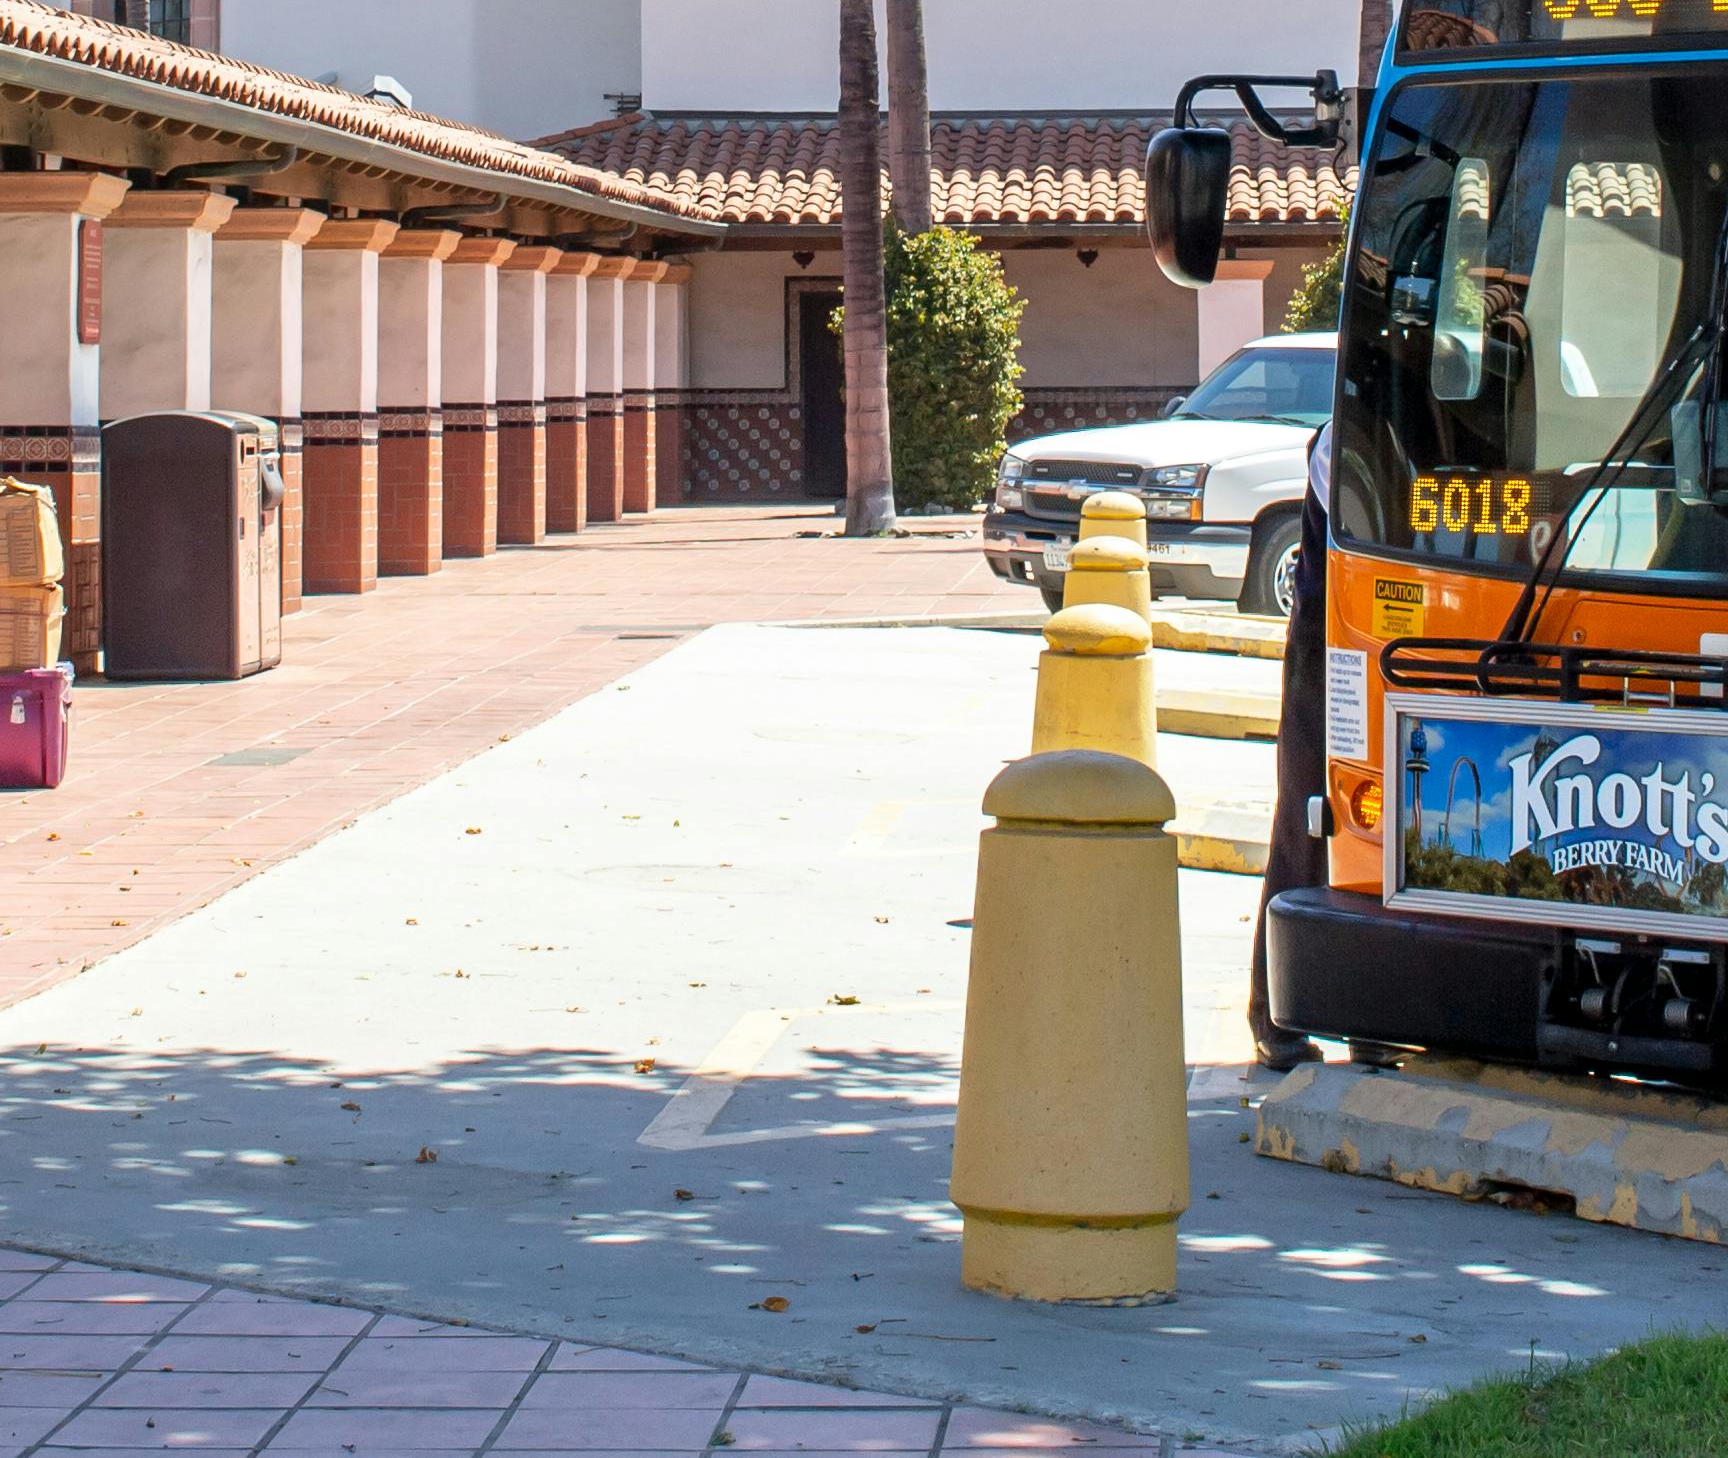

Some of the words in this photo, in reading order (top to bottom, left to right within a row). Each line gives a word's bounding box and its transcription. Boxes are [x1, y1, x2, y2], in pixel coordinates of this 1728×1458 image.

[1410, 477, 1532, 534] 6018
[1376, 581, 1422, 603] CAUTION
[1552, 839, 1622, 877] BERRY
[1623, 842, 1685, 887] FARM
